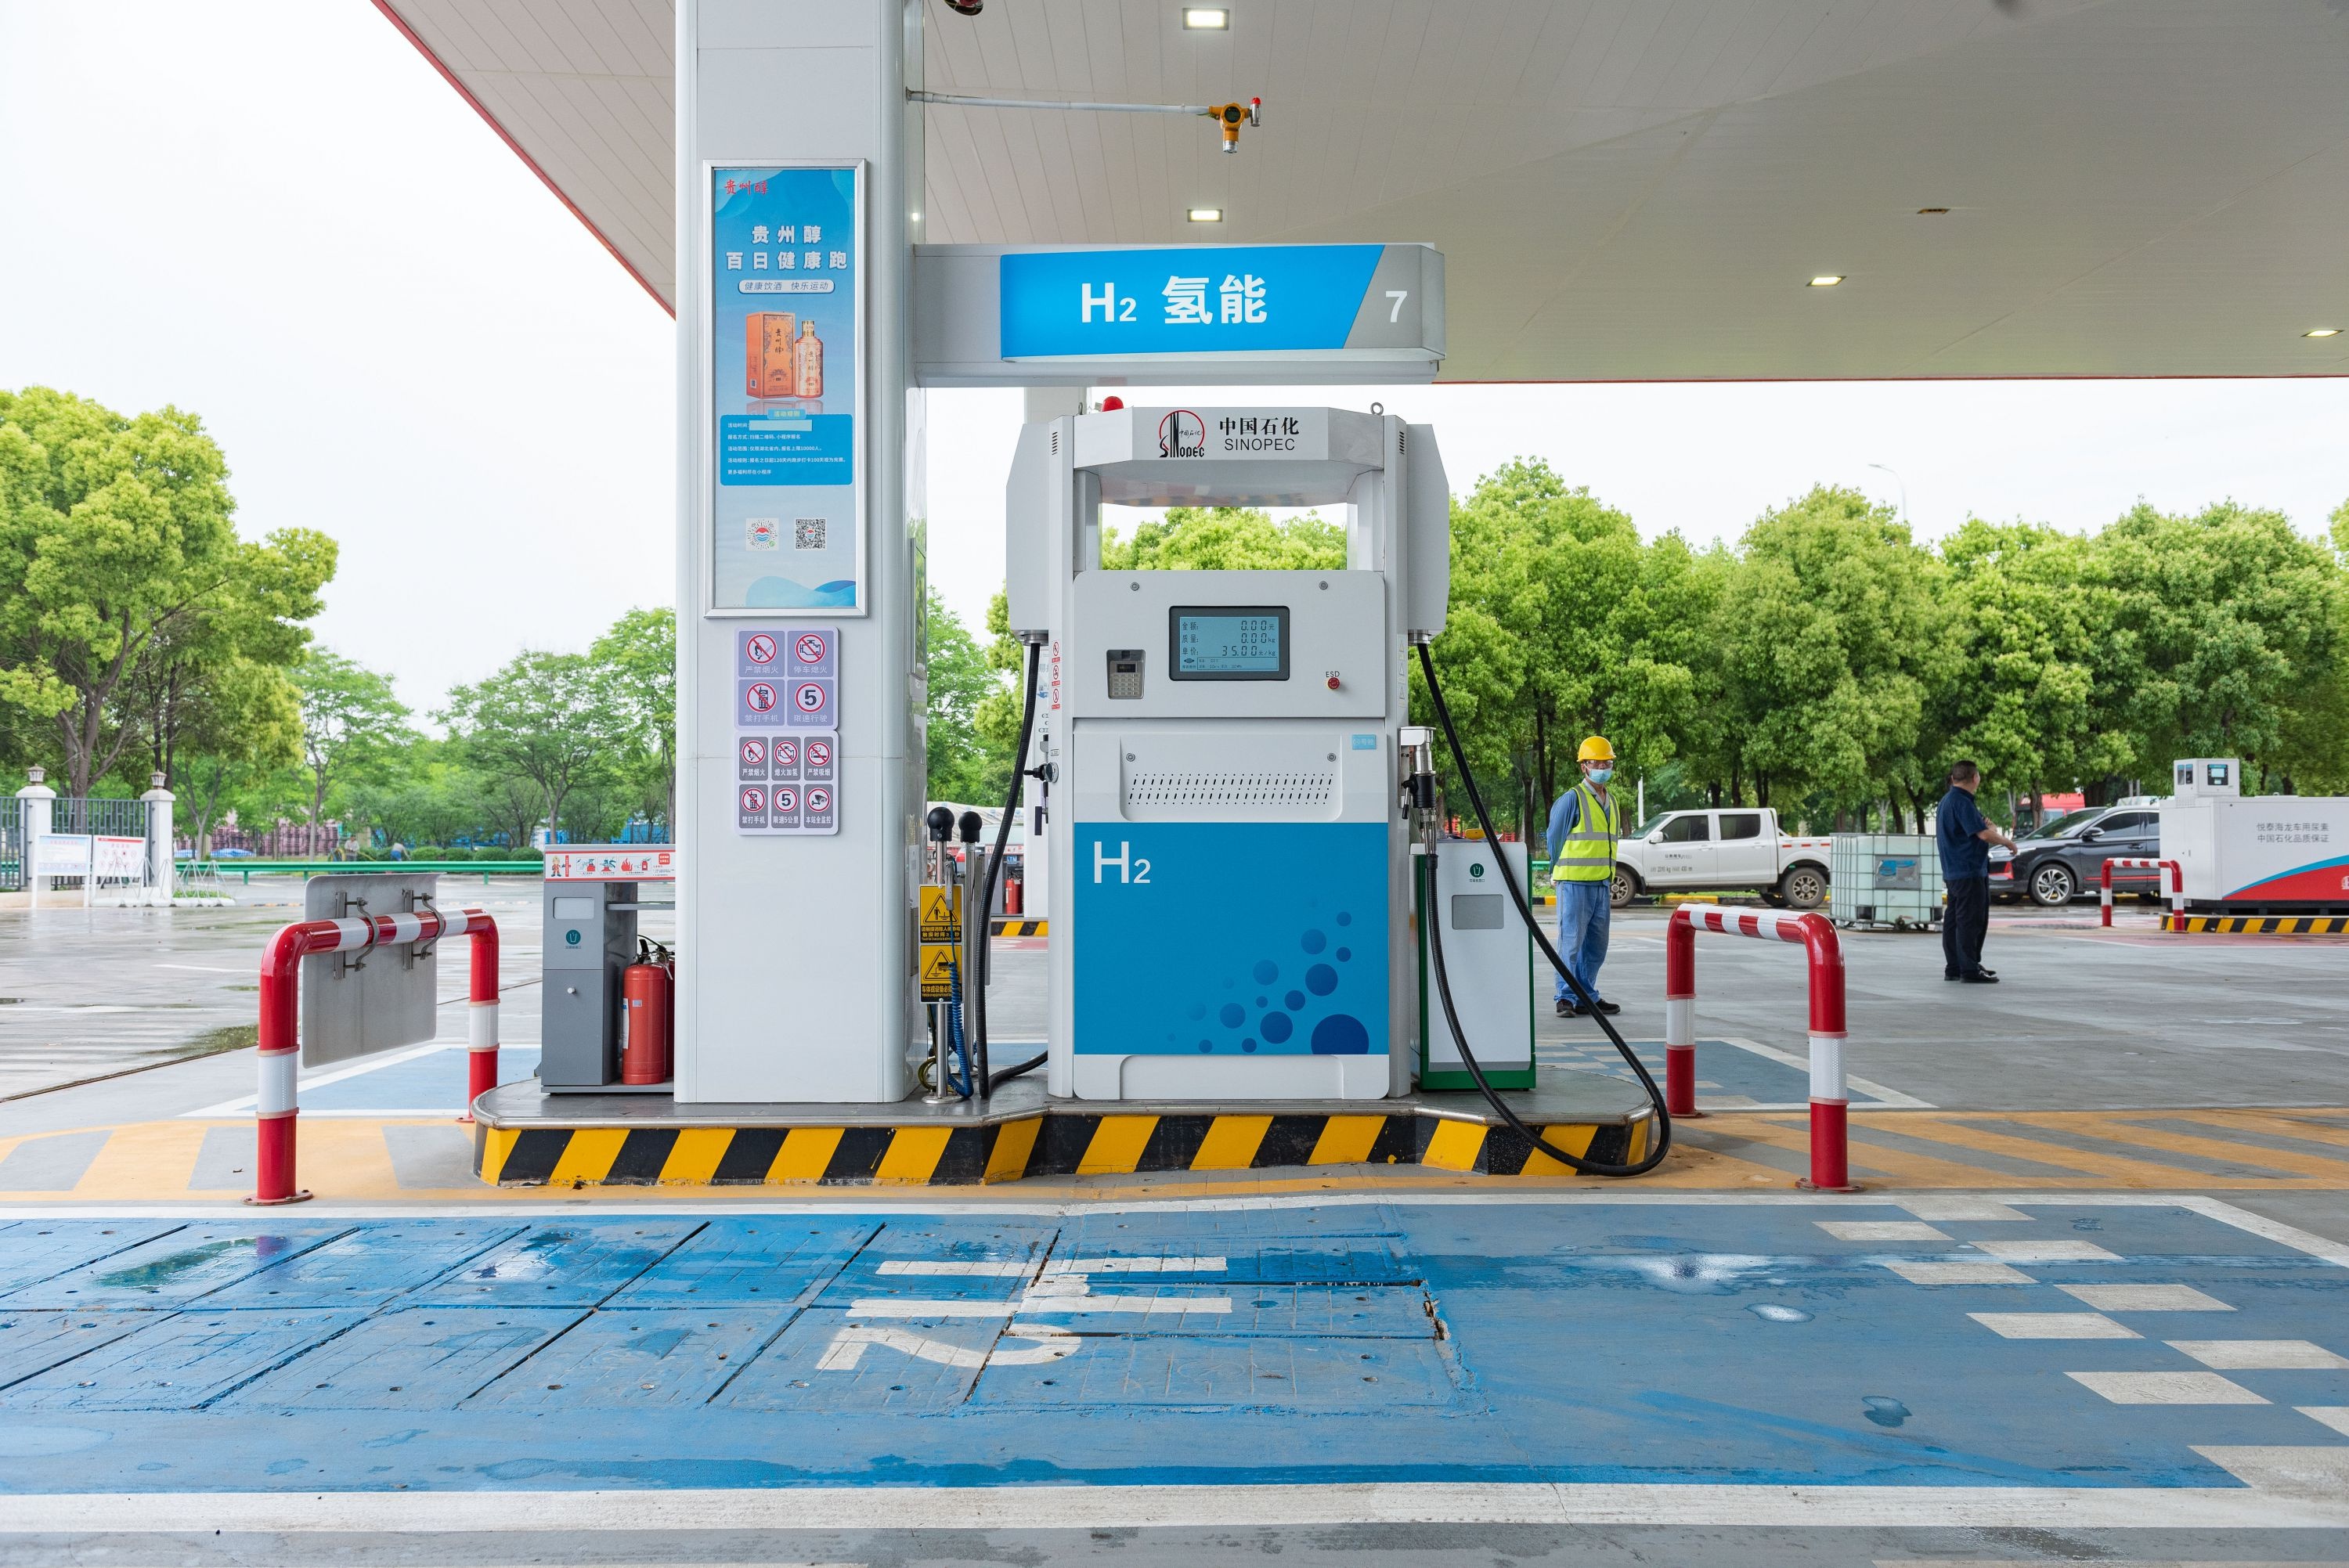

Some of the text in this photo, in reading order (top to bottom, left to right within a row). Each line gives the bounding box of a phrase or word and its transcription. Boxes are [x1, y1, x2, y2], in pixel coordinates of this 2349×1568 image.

[723, 179, 769, 196] 贵州醇
[752, 225, 821, 244] 贵州醇
[726, 251, 847, 270] 百日健康跑
[745, 281, 828, 290] 健康饮酒 快乐运动
[1081, 273, 1268, 325] H2 氢能
[1385, 290, 1408, 323] 7
[1219, 416, 1300, 436] 中国石化
[1225, 438, 1295, 451] SINOPEC
[1241, 620, 1267, 631] 0.00
[1241, 633, 1267, 643] 0.00
[1222, 645, 1257, 656] 35.00
[745, 665, 778, 674] 严禁烟火
[794, 665, 828, 674] 停车熄火
[804, 690, 817, 706] 5
[745, 714, 778, 723] 禁打手机
[794, 714, 828, 723] 限速行驶
[742, 768, 765, 777] 严禁烟火
[807, 768, 831, 777] 严禁吸烟
[781, 794, 791, 806] 5
[742, 816, 765, 824] 禁打手机
[773, 816, 799, 824] 限速5公里
[2257, 834, 2330, 843] 中国石化品质保证
[1094, 841, 1151, 883] H2
